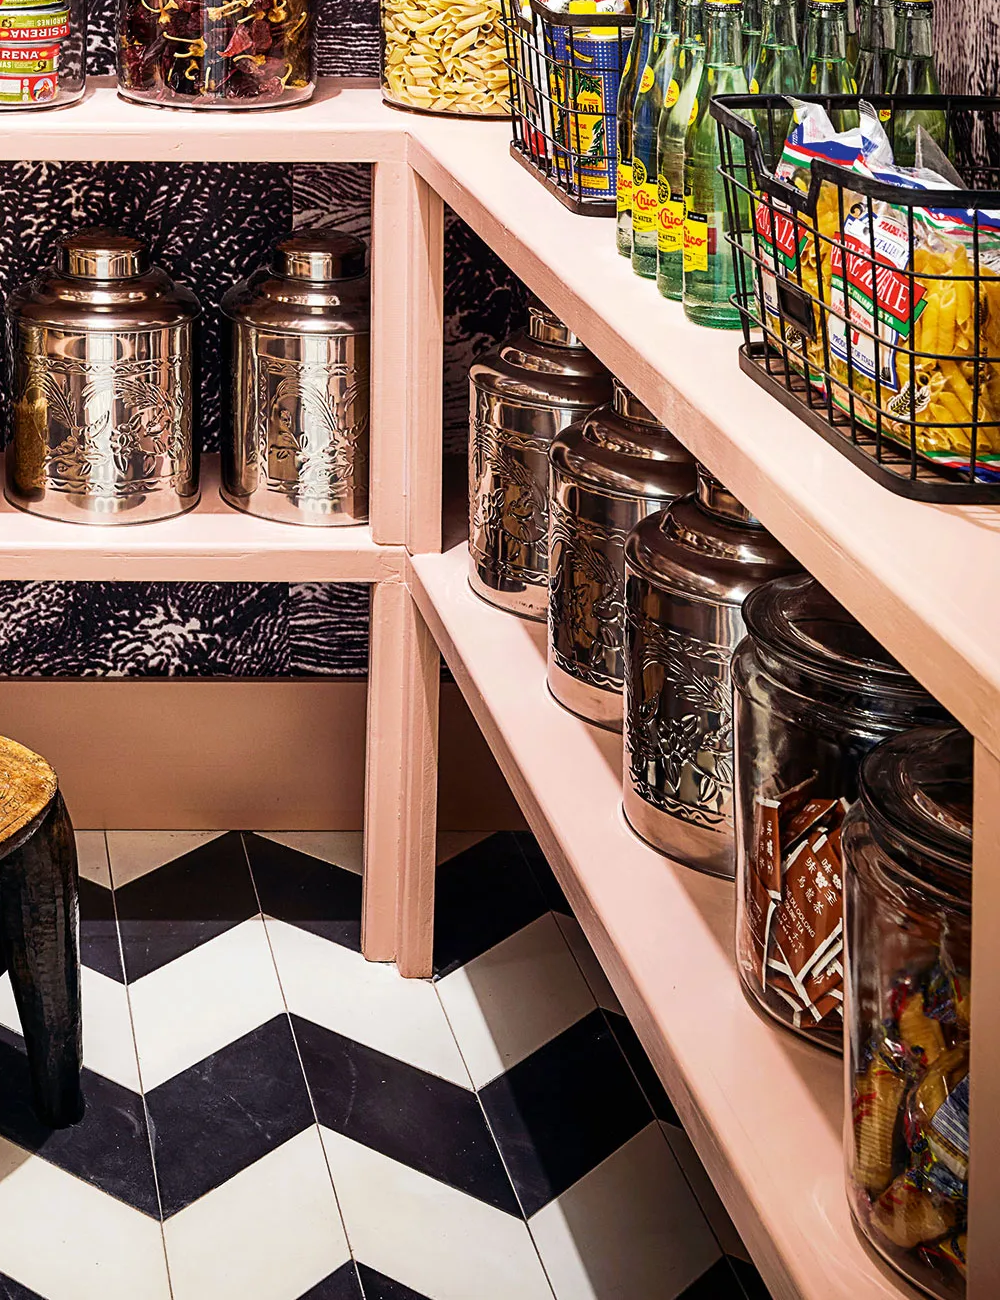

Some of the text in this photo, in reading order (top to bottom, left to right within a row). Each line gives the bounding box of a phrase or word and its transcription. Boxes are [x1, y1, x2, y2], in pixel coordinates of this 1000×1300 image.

[10, 26, 60, 38] SIRENA
[639, 216, 652, 224] WATER
[796, 905, 816, 939] OOLONG
[796, 922, 805, 935] TEA
